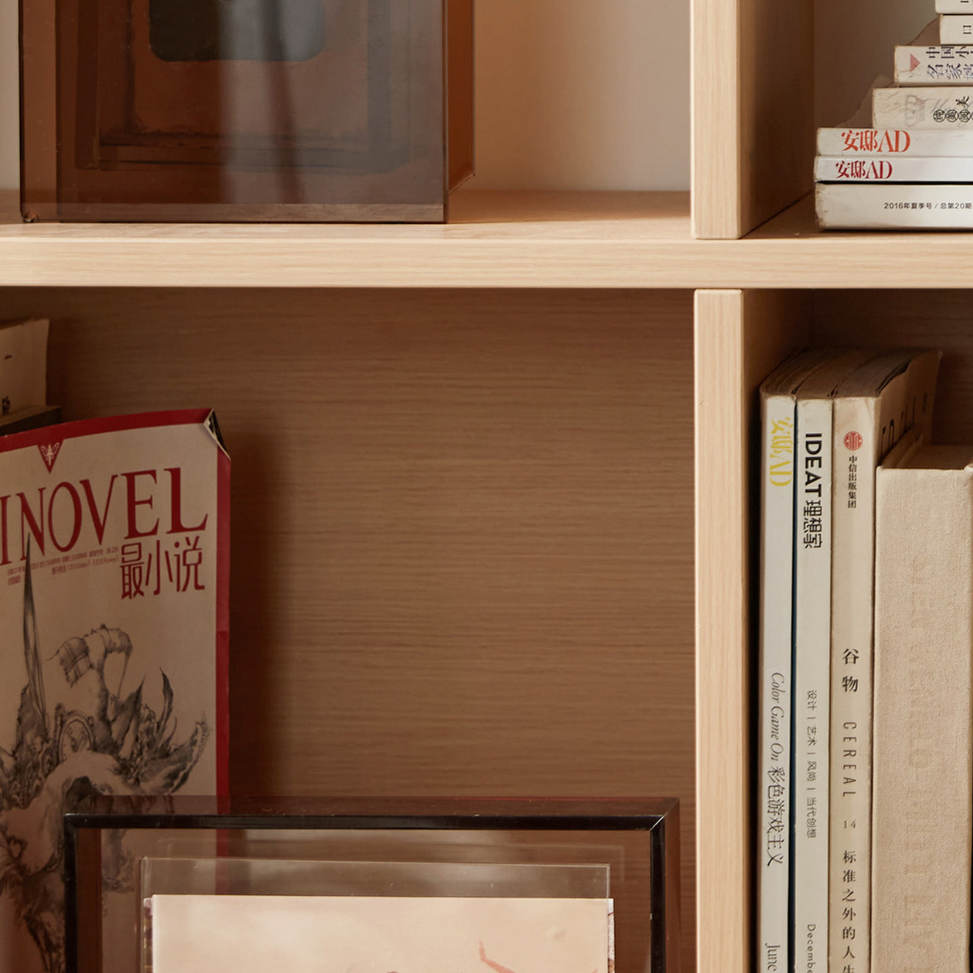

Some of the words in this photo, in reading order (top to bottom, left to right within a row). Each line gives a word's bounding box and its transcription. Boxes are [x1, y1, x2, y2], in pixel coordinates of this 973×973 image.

[841, 130, 911, 153] 安邸AD
[835, 160, 893, 179] 安邸AD
[847, 455, 858, 509] 中信出版集团
[120, 536, 205, 600] 最小说
[842, 648, 859, 693] 谷物
[770, 672, 786, 703] Color
[807, 690, 818, 710] 设计
[770, 706, 785, 741] Game
[807, 725, 818, 747] 艺术
[770, 743, 784, 762] On
[843, 721, 857, 798] CEREAL
[807, 761, 818, 782] 风尚
[767, 766, 786, 867] 彩色游戏主义
[842, 850, 857, 973] 标准之外的人生
[765, 942, 781, 972] June
